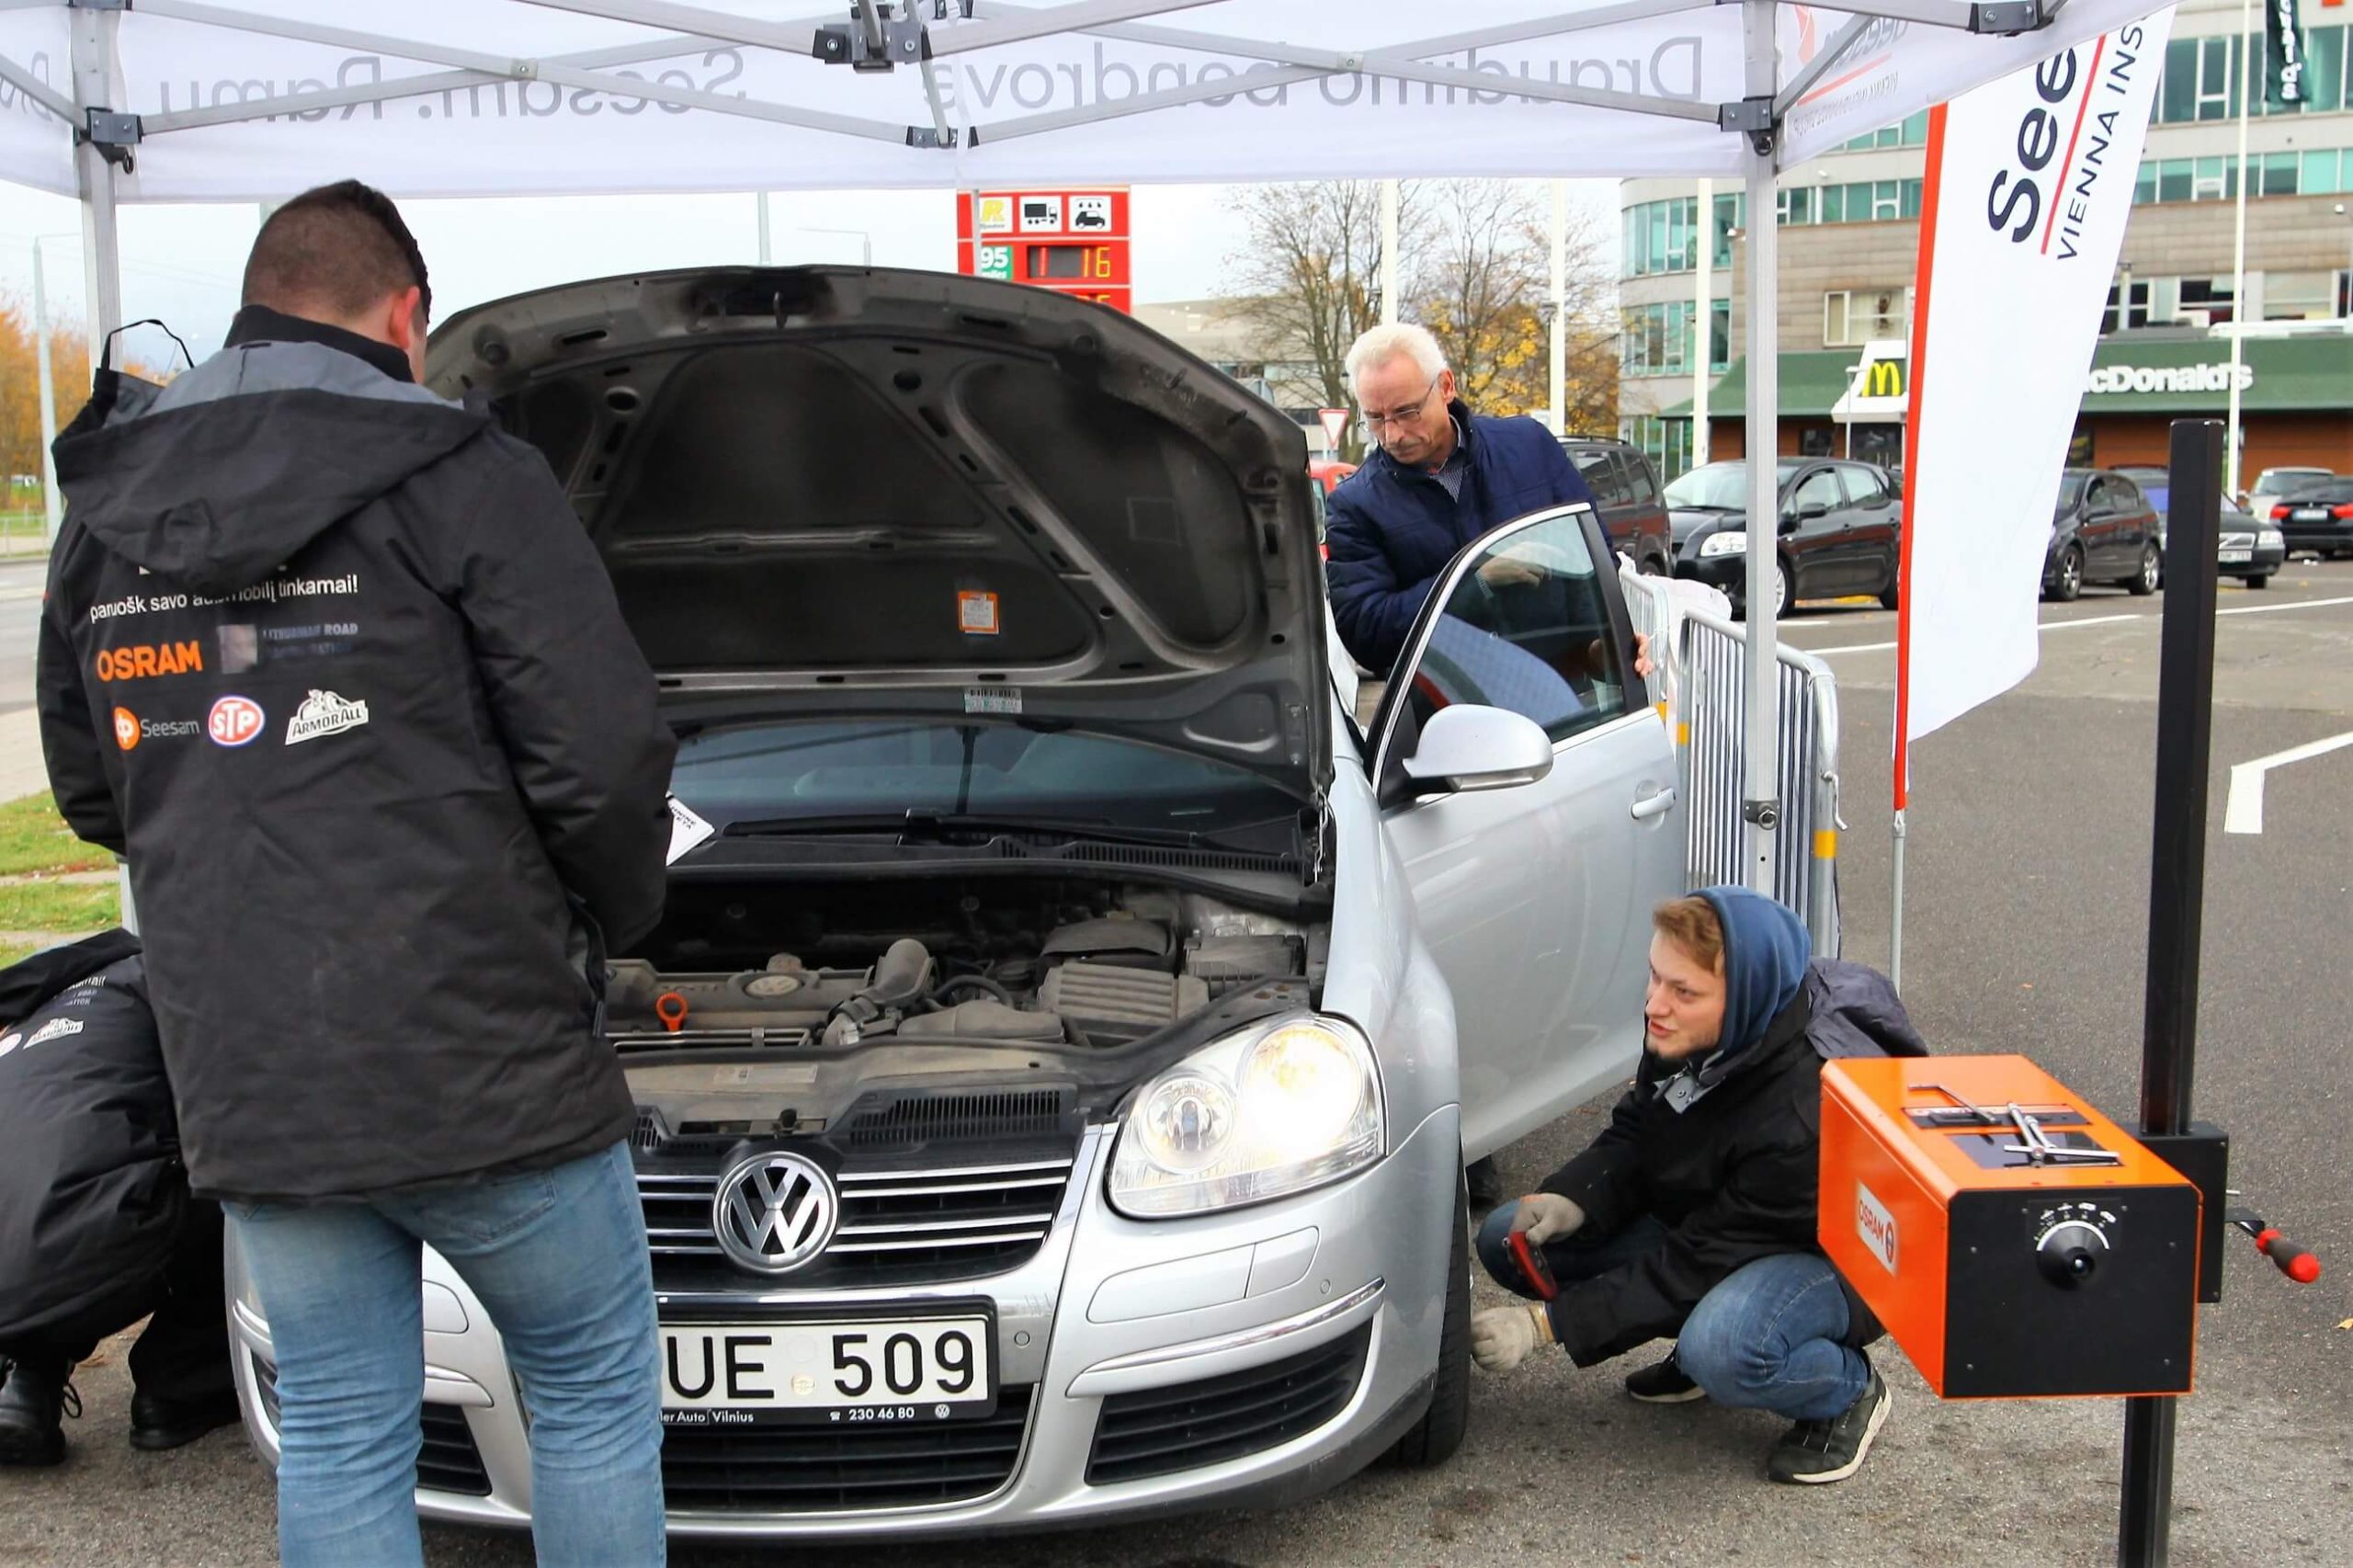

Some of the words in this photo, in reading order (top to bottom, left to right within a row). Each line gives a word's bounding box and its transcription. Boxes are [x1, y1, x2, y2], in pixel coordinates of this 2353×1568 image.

[2057, 111, 2120, 259] VIENNA
[2106, 25, 2143, 95] INS
[981, 247, 1008, 268] 95
[2083, 364, 2253, 393] cDonald's
[150, 594, 187, 610] savo
[278, 574, 358, 598] tinkamai!
[324, 623, 358, 636] ROAD
[97, 641, 203, 682] OSRAM
[140, 718, 200, 738] Seesam
[210, 702, 256, 738] STP
[1859, 1199, 1884, 1245] OSRAM
[832, 1330, 974, 1397] 509
[676, 1410, 705, 1423] Auto
[712, 1409, 754, 1423] Vilnius
[848, 1408, 874, 1420] 230
[877, 1407, 895, 1420] 46
[897, 1406, 915, 1419] 80
